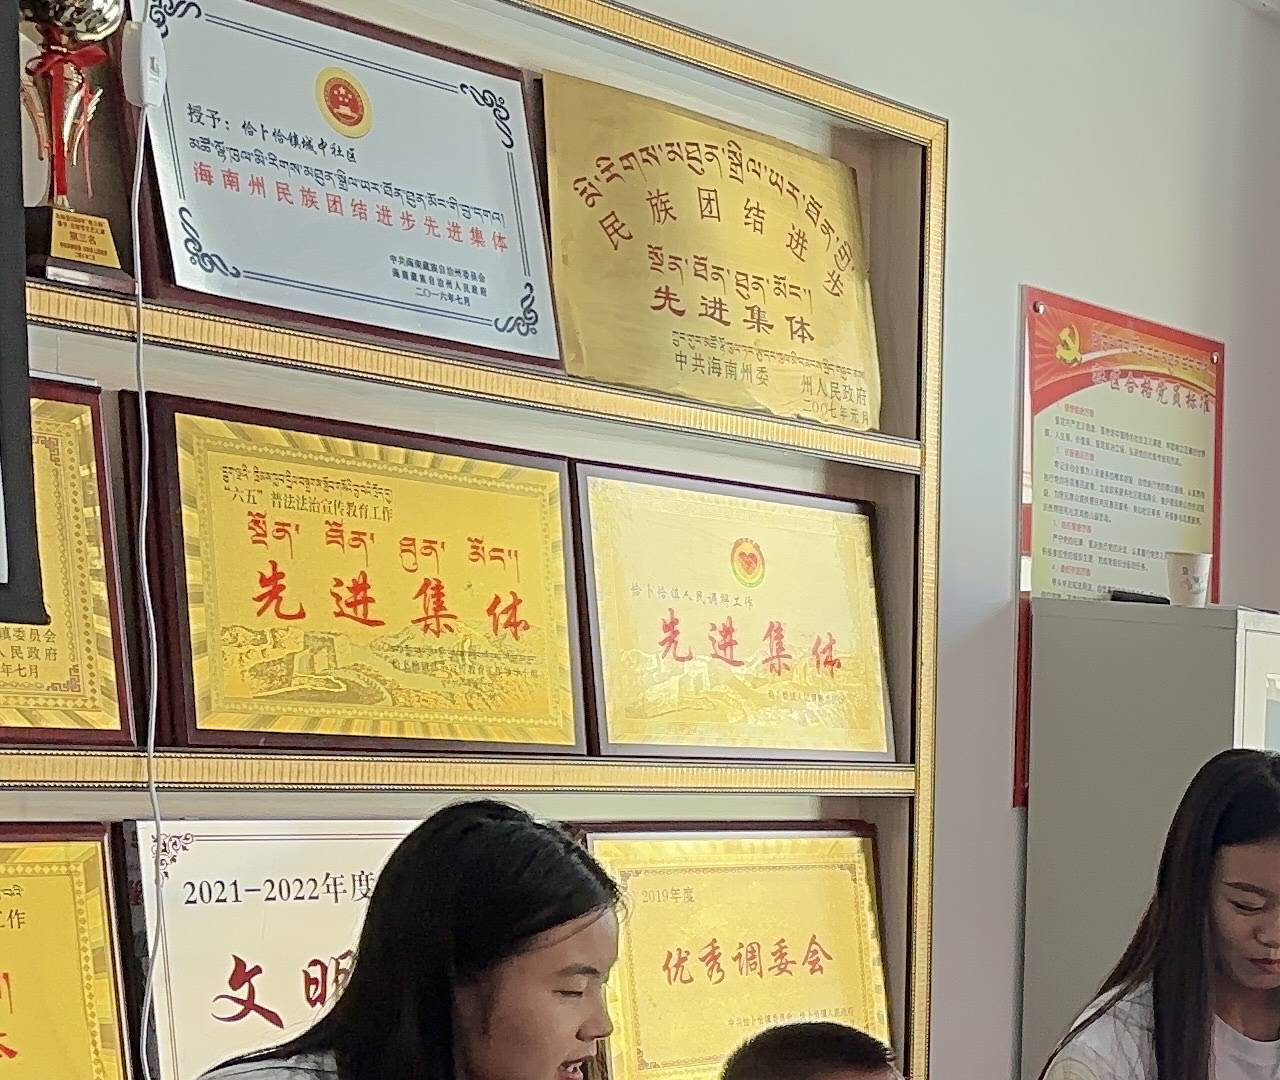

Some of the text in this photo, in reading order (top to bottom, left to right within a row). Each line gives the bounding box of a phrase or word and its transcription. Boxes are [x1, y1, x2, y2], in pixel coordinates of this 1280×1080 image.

[192, 161, 508, 252] 海南州民族团结进步先进集体
[599, 186, 845, 298] 民族团结进步
[650, 285, 816, 344] 先进集体
[675, 350, 769, 387] 中共海南州委
[801, 375, 867, 406] 州人民政府
[1092, 364, 1211, 415] 社区合格党员标准
[252, 560, 530, 641] 先进集体
[658, 607, 842, 679] 先进集体
[183, 871, 376, 904] 2021-2022年度
[0, 909, 26, 929] 作
[662, 934, 833, 985] 优秀调委会
